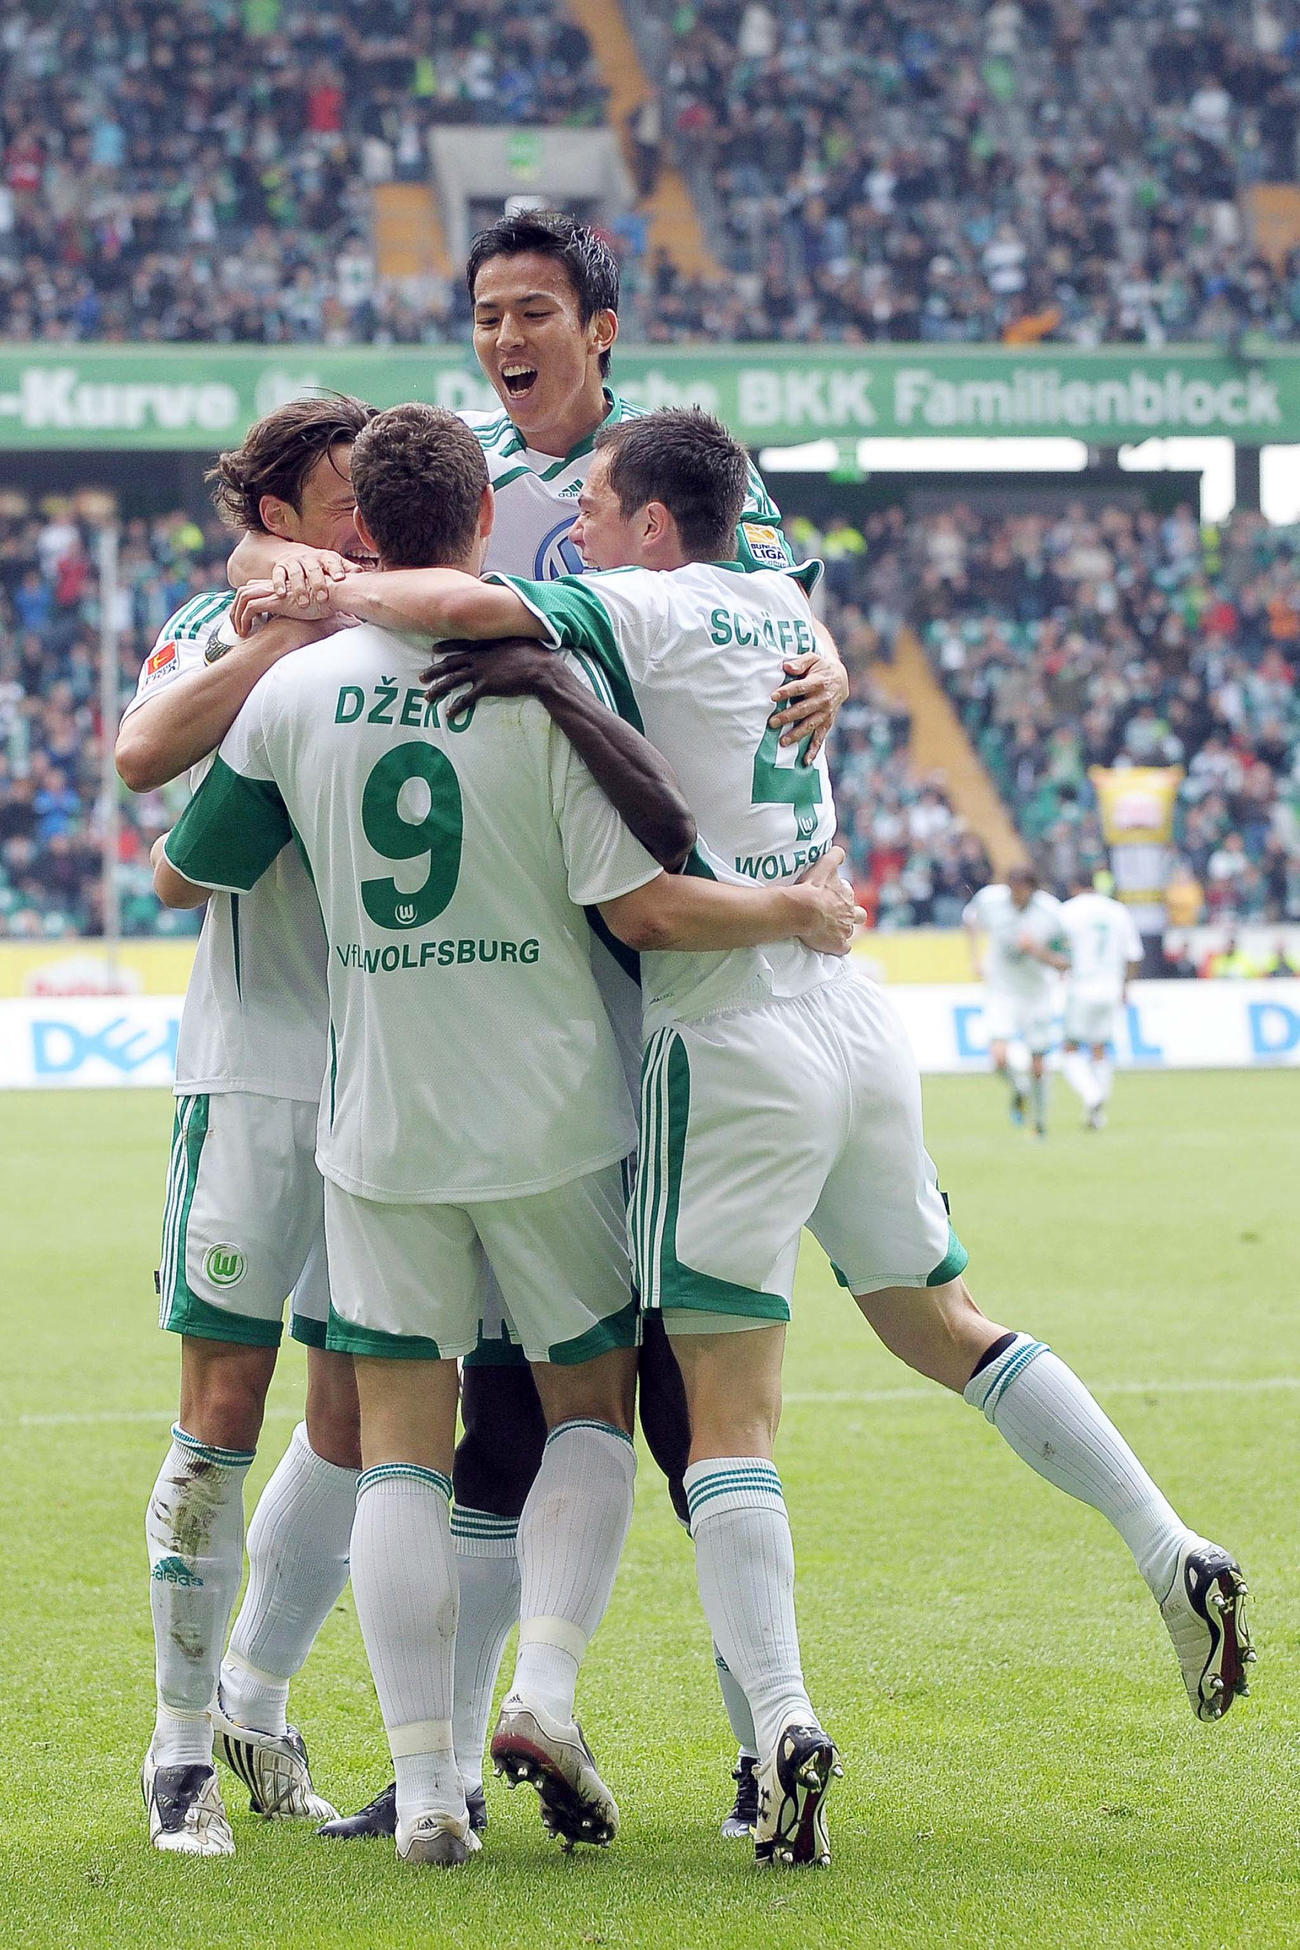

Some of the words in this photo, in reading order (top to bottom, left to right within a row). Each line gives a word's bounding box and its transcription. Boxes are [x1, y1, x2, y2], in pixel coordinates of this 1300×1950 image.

[737, 369, 876, 427] BKK
[894, 369, 1282, 428] Familienblock
[752, 549, 786, 561] LIGA
[751, 660, 823, 841] 4
[360, 741, 463, 930] 9
[336, 943, 363, 968] VfL
[363, 938, 540, 974] WOLFSBURG
